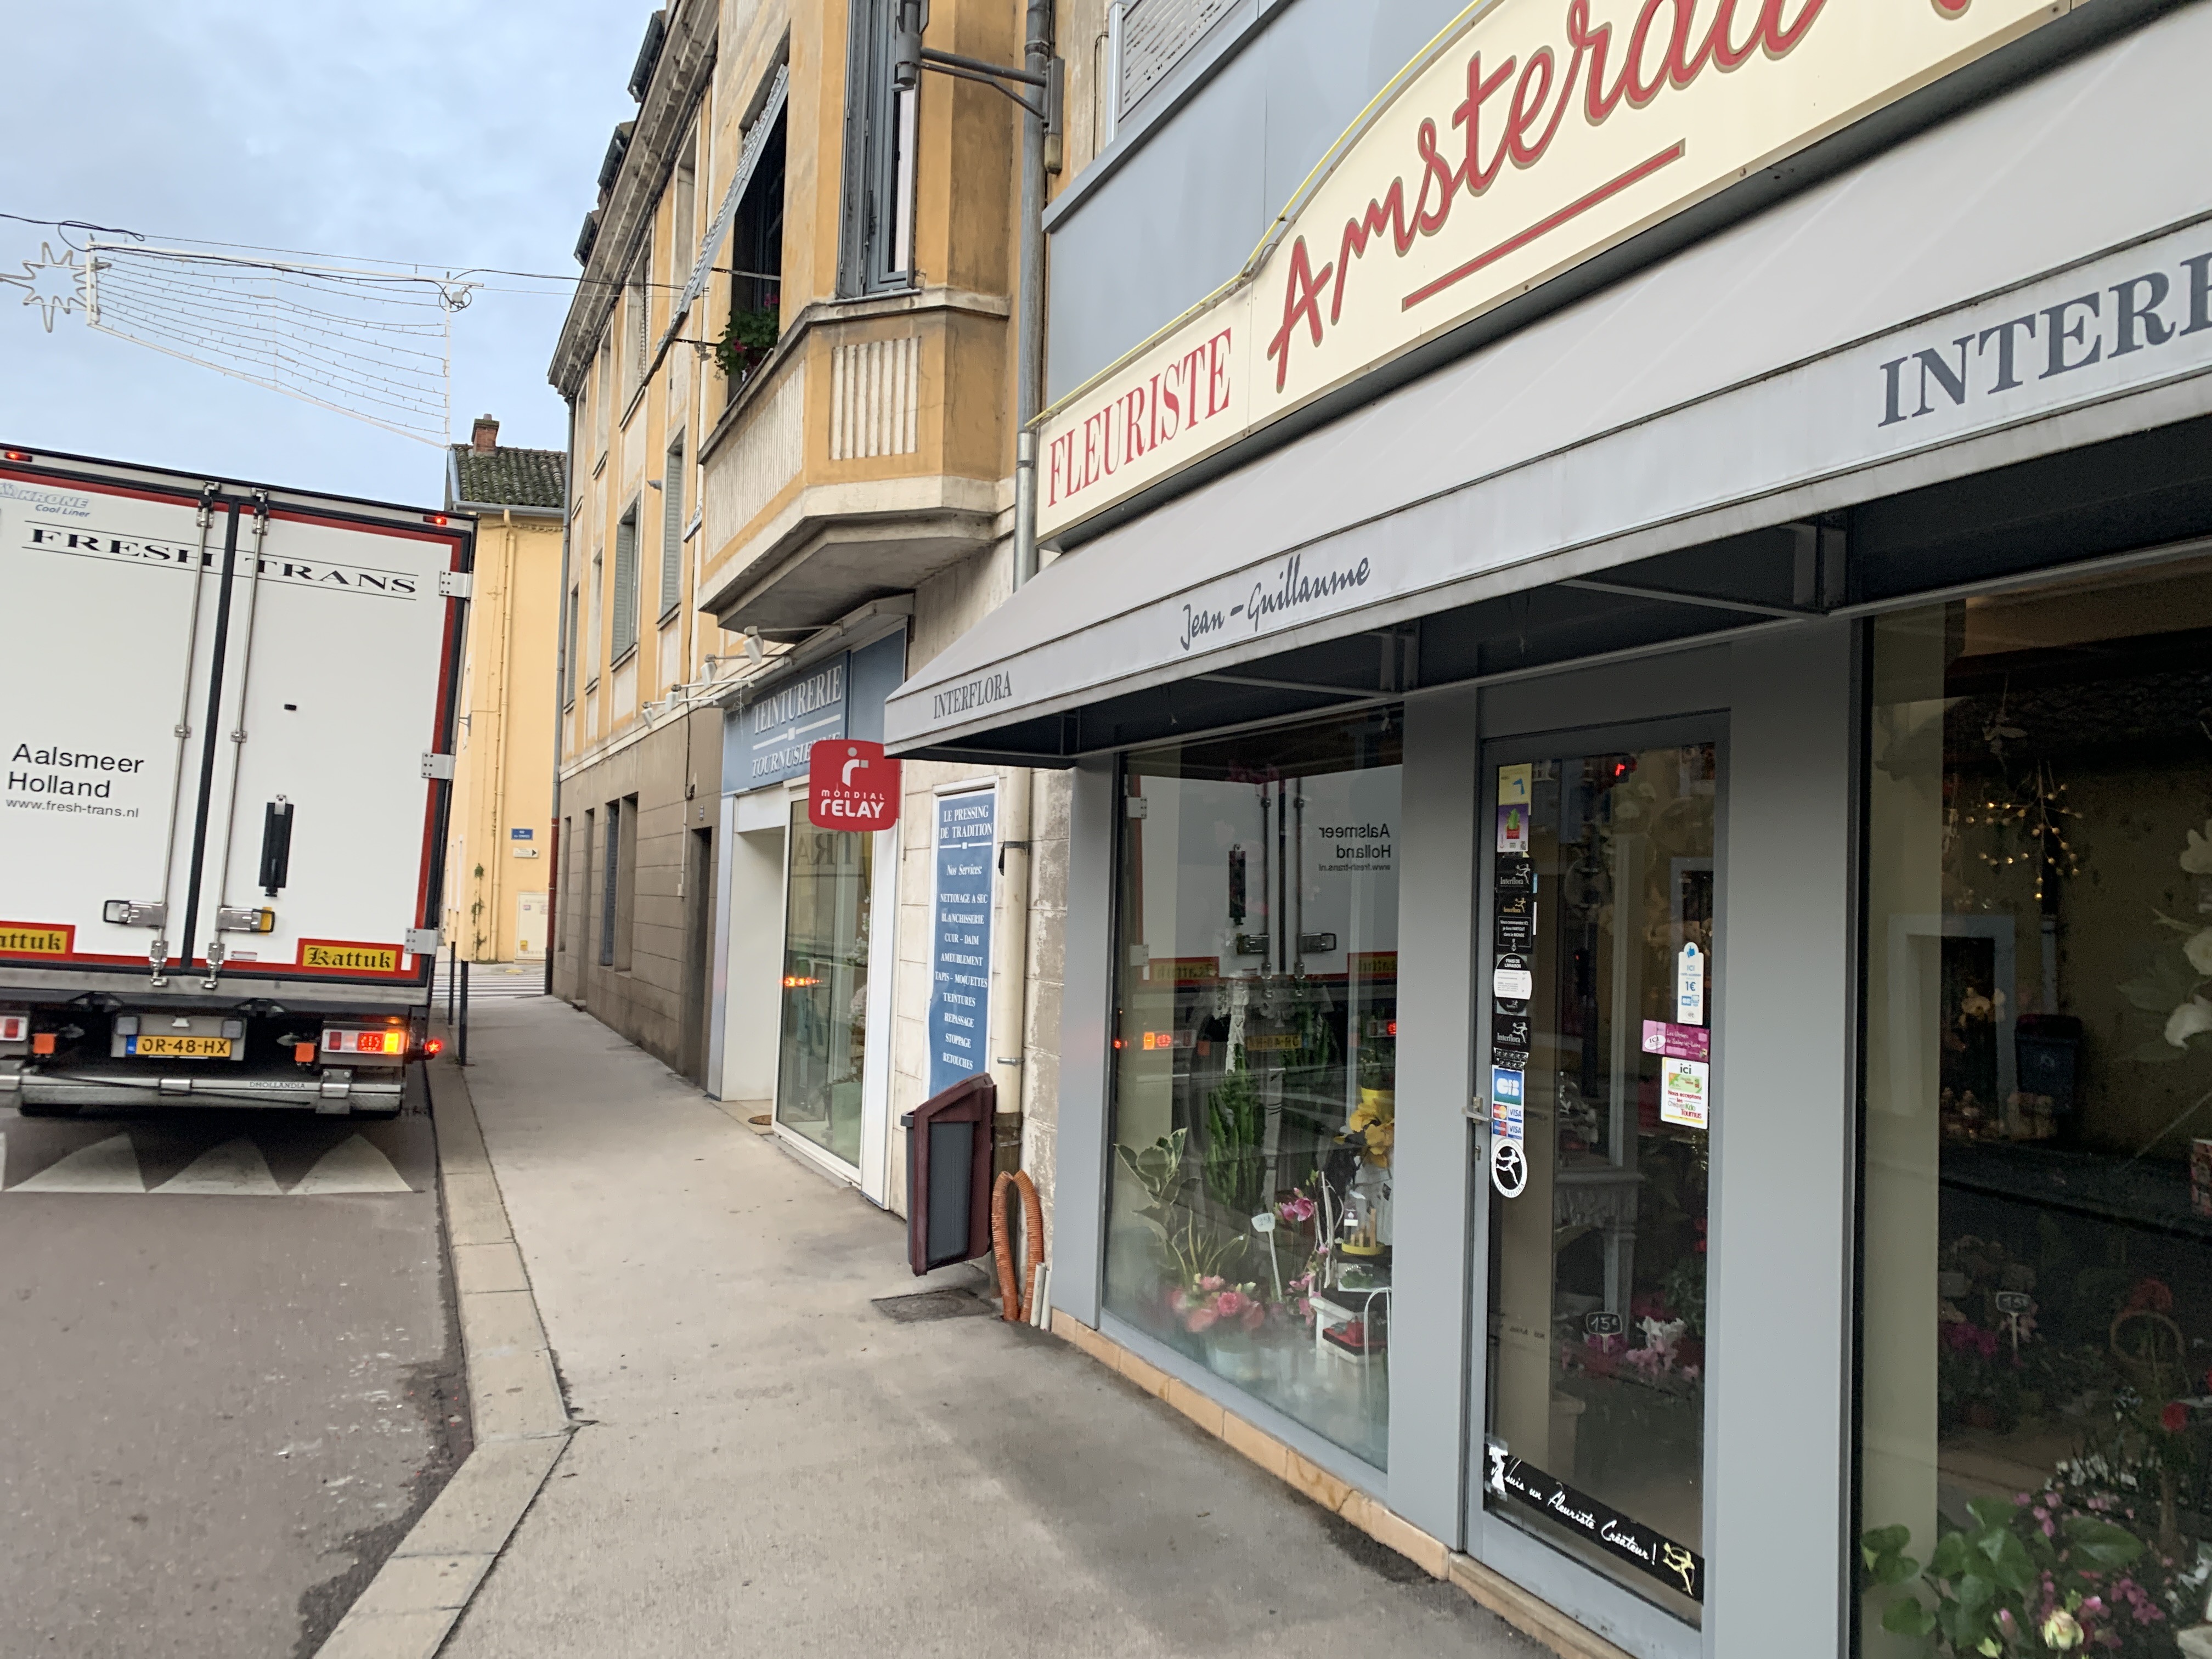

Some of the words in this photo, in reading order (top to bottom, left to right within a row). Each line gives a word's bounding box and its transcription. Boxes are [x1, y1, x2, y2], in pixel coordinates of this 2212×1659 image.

[1048, 326, 1232, 508] FLEURISTE
[18, 489, 89, 509] KRONE
[35, 504, 60, 514] Cool
[61, 507, 91, 517] Liner
[31, 528, 217, 568] FRESH
[245, 557, 416, 594] TRANS
[754, 664, 843, 735] TEINTURERIE
[934, 670, 1012, 720] INTERFLORA
[12, 743, 144, 774] Aalsmeer
[8, 771, 111, 798] Holland
[5, 799, 139, 818] www.fresh-trans.nl
[944, 810, 952, 822] LE
[954, 805, 989, 821] PRESSING
[940, 827, 949, 839] DE
[952, 822, 993, 839] TRADITION
[946, 865, 957, 876] Nos
[1500, 876, 1523, 885] Interflora
[940, 893, 970, 903] NETTOYAGE
[972, 894, 975, 904] A
[977, 894, 988, 904] SEC
[941, 913, 984, 924] BLANCHISSERIE
[944, 933, 958, 943] CUIR
[964, 934, 979, 945] DAIM
[307, 947, 392, 969] Kattuk
[940, 953, 983, 966] AMEUBLEMENT
[935, 971, 950, 981] TAPIS
[955, 974, 988, 988] MOQUETTES
[1685, 981, 1696, 991] 1€
[943, 992, 976, 1007] TEINTURES
[944, 1012, 974, 1028] REPASSAGE
[945, 1033, 971, 1048] STOPPAGE
[1497, 1032, 1521, 1043] Interflora
[142, 1038, 228, 1054] OR-48-HX
[943, 1052, 973, 1070] RETOUCHES
[1680, 1063, 1692, 1074] ici
[249, 1080, 306, 1090] DHOLLANDIA
[1510, 1108, 1522, 1118] VISA
[1509, 1125, 1522, 1134] VISA
[1530, 1487, 1542, 1500] un
